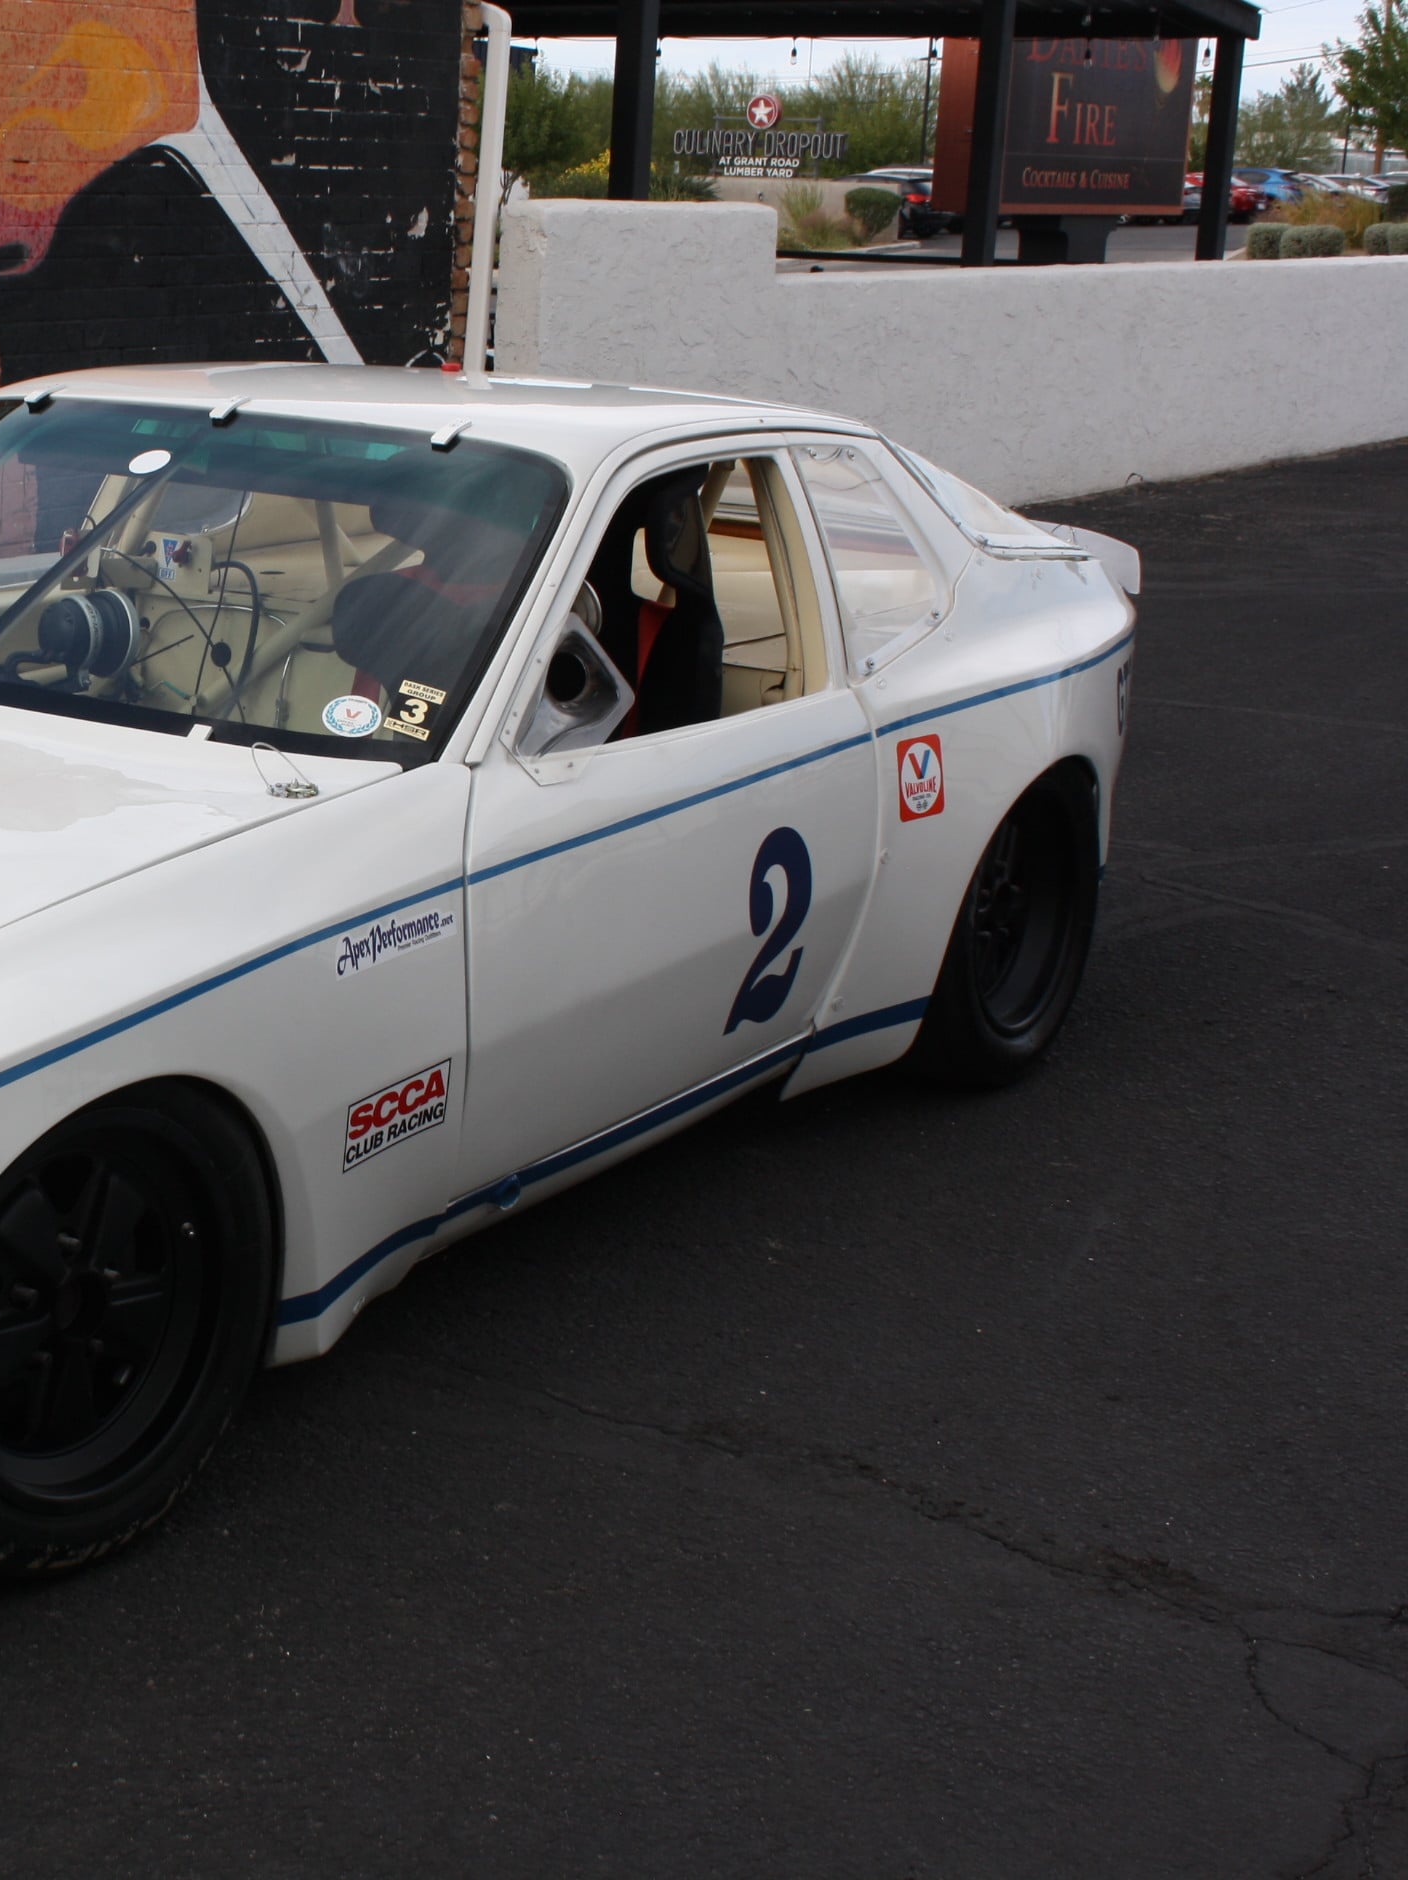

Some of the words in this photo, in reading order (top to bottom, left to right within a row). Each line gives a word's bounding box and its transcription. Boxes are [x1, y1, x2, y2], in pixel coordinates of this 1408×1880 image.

[1046, 71, 1118, 146] FIRE
[673, 129, 757, 156] CULINARY
[764, 131, 846, 159] DROPOUT
[719, 156, 731, 166] AT
[734, 157, 767, 168] GRANT
[771, 157, 800, 168] ROAD
[724, 167, 763, 177] LUMBER
[766, 168, 793, 178] YARD
[1023, 166, 1077, 188] COCKTAILS
[1090, 168, 1131, 190] CUISINE
[407, 688, 437, 701] GROUP
[399, 698, 429, 725] 3
[904, 776, 937, 799] VALVOLINE
[722, 826, 812, 1036] 2
[348, 1069, 446, 1140] SCCA
[345, 1130, 384, 1165] CLUB
[386, 1102, 444, 1143] RACING
